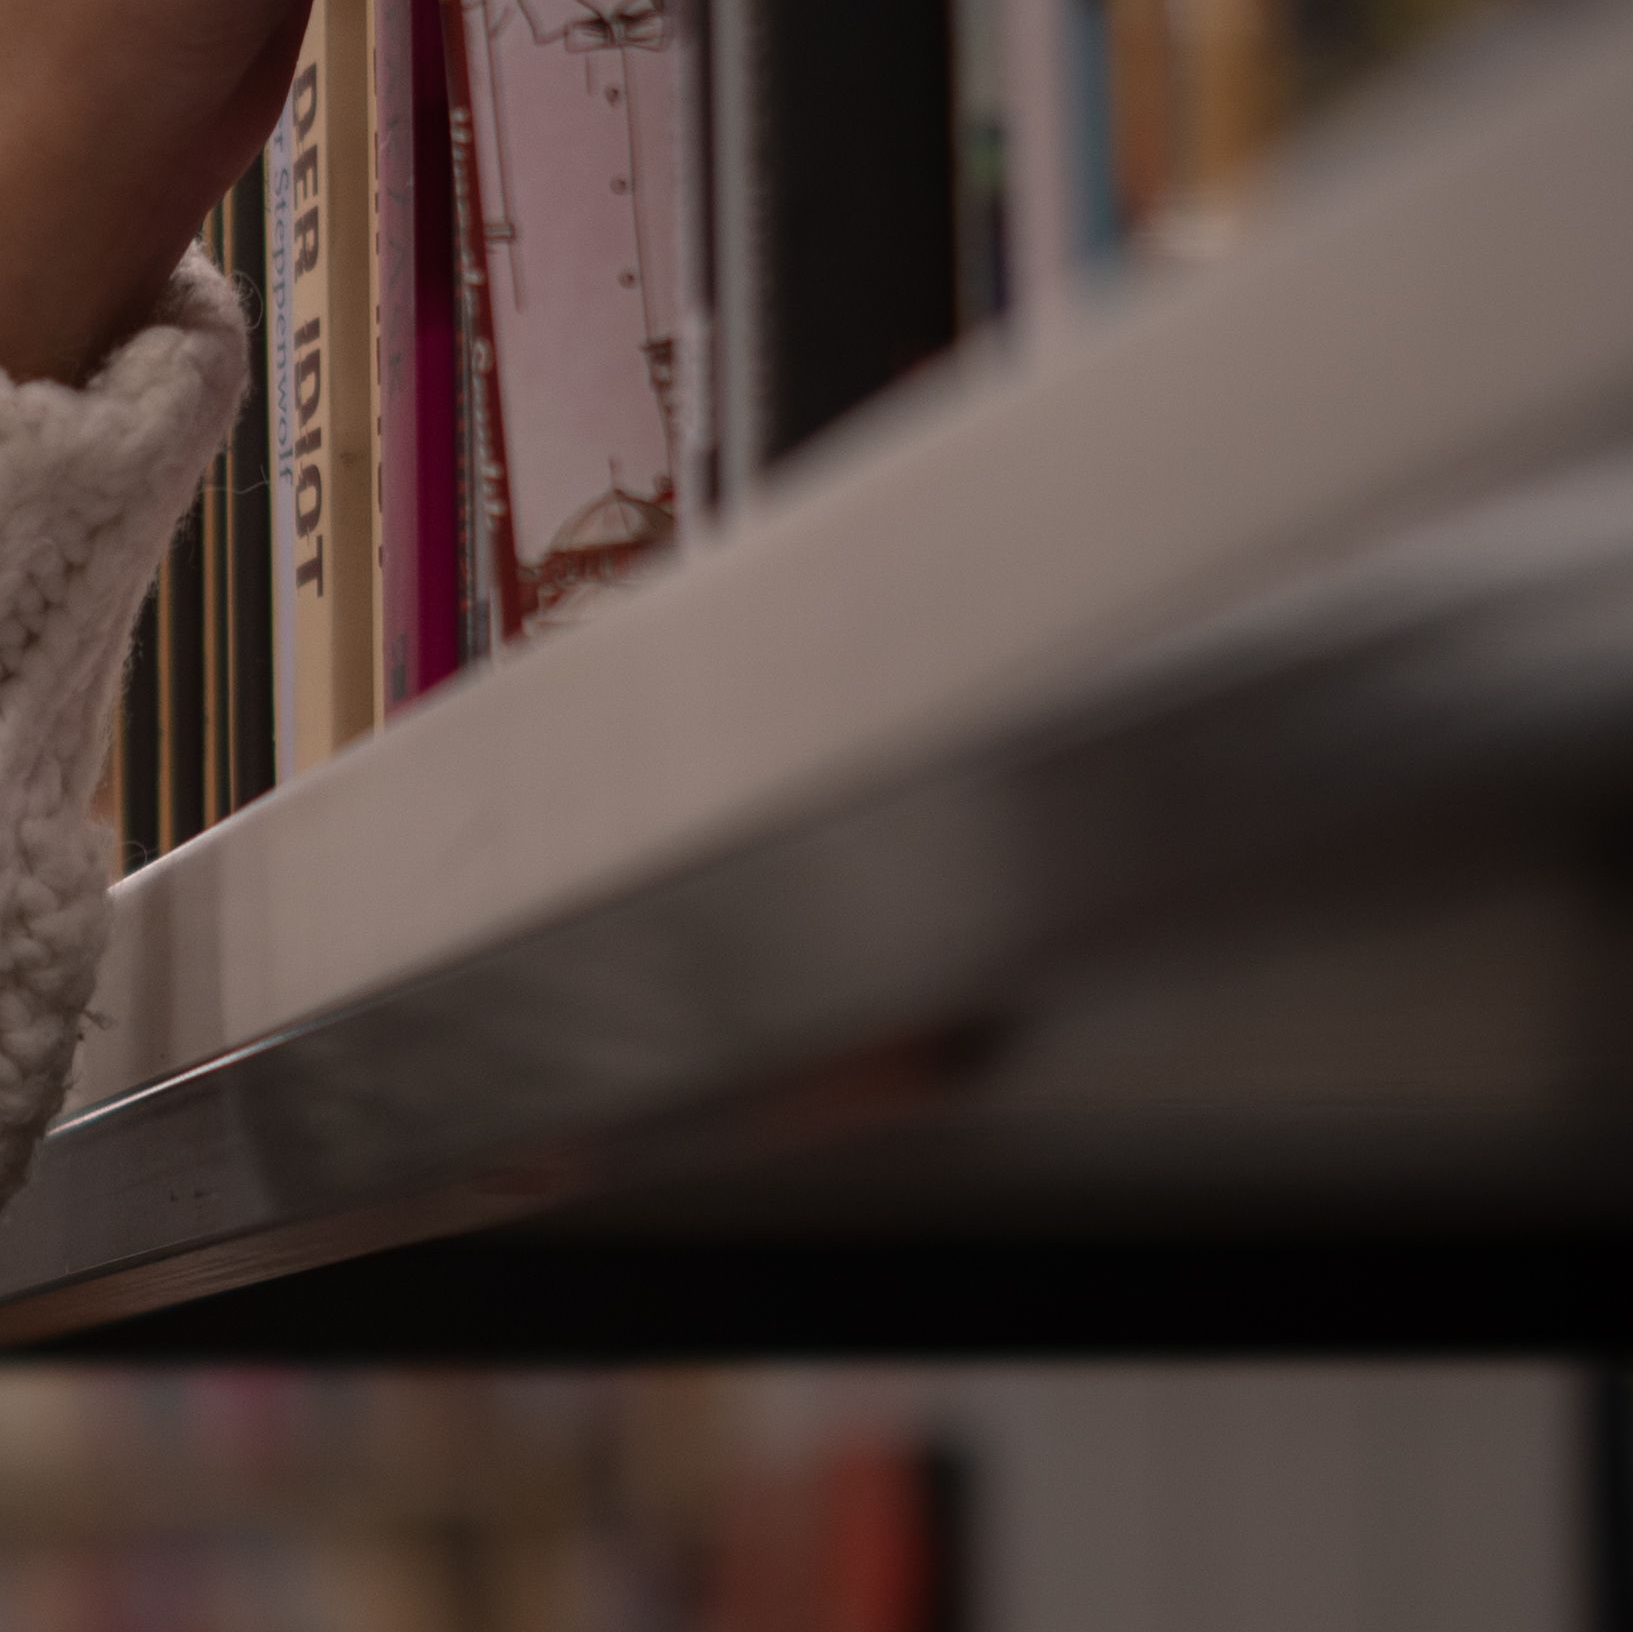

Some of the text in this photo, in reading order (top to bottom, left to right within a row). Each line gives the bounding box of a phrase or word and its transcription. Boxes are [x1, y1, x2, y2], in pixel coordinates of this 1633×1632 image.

[270, 167, 294, 486] Steppenwolf
[291, 61, 324, 598] DER IDIOT
